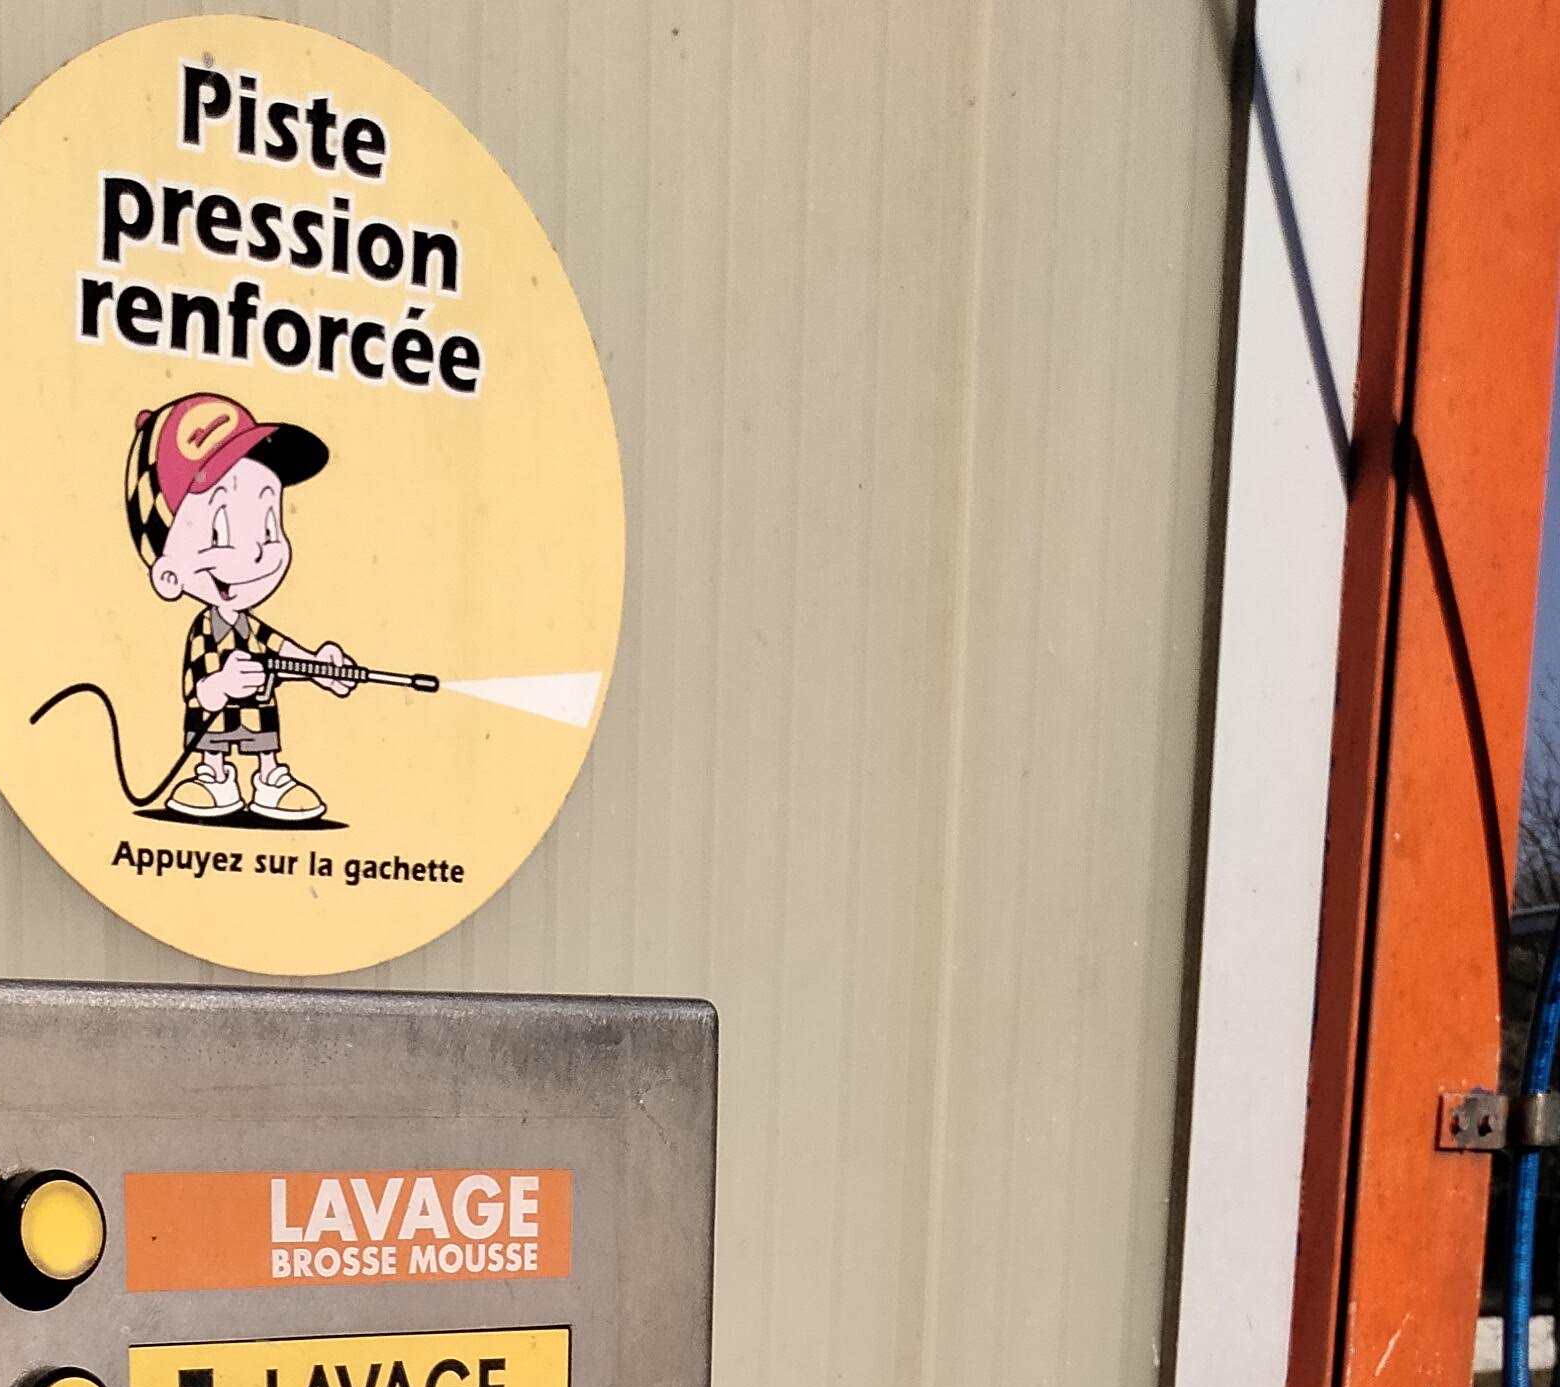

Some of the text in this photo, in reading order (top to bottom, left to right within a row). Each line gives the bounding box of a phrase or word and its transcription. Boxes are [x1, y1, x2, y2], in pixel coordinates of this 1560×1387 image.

[184, 67, 385, 177] Piste
[104, 178, 457, 291] pression
[82, 279, 479, 392] renforcée
[112, 841, 464, 885] Appuyez sur la gachette
[272, 1175, 539, 1242] LAVAGE
[272, 1243, 538, 1277] BROSSE MOUSSE
